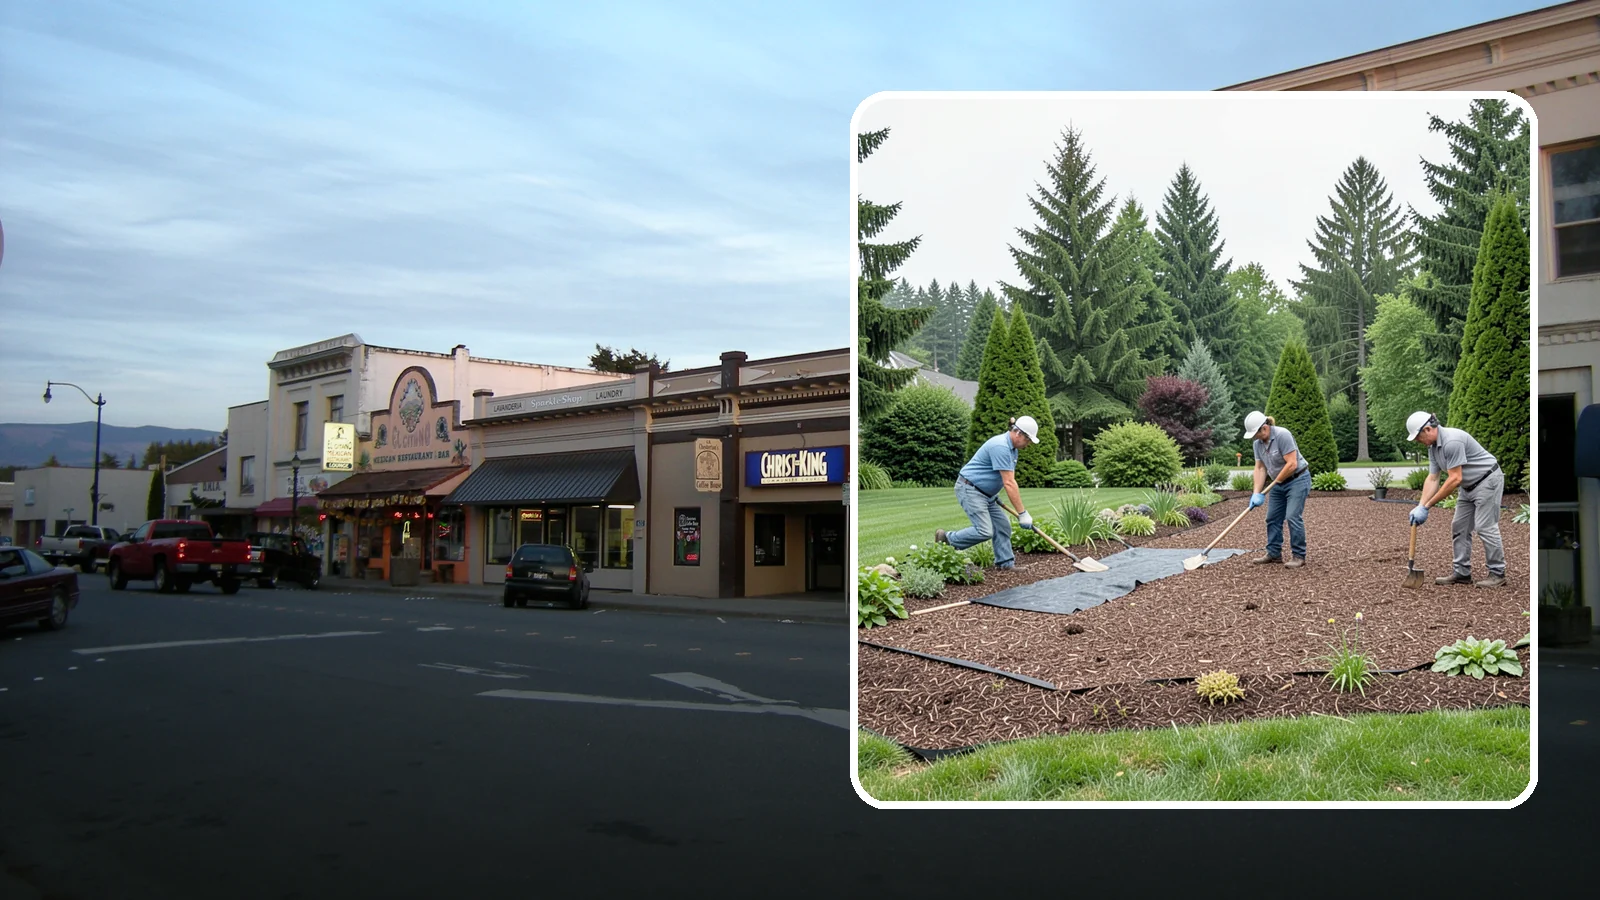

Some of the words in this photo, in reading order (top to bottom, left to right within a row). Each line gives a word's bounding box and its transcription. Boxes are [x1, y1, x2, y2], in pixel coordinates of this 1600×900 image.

[595, 389, 624, 401] LAUNDRY
[493, 402, 522, 413] LAVANDERIA
[530, 397, 561, 409] Sparkle
[562, 395, 583, 407] Shop
[373, 454, 396, 464] MEXICAN
[398, 451, 434, 463] RESTAURANT
[438, 450, 450, 460] BAR
[761, 452, 798, 478] CHRIST
[799, 450, 828, 477] KING
[697, 480, 709, 489] Coffee
[710, 481, 722, 489] House
